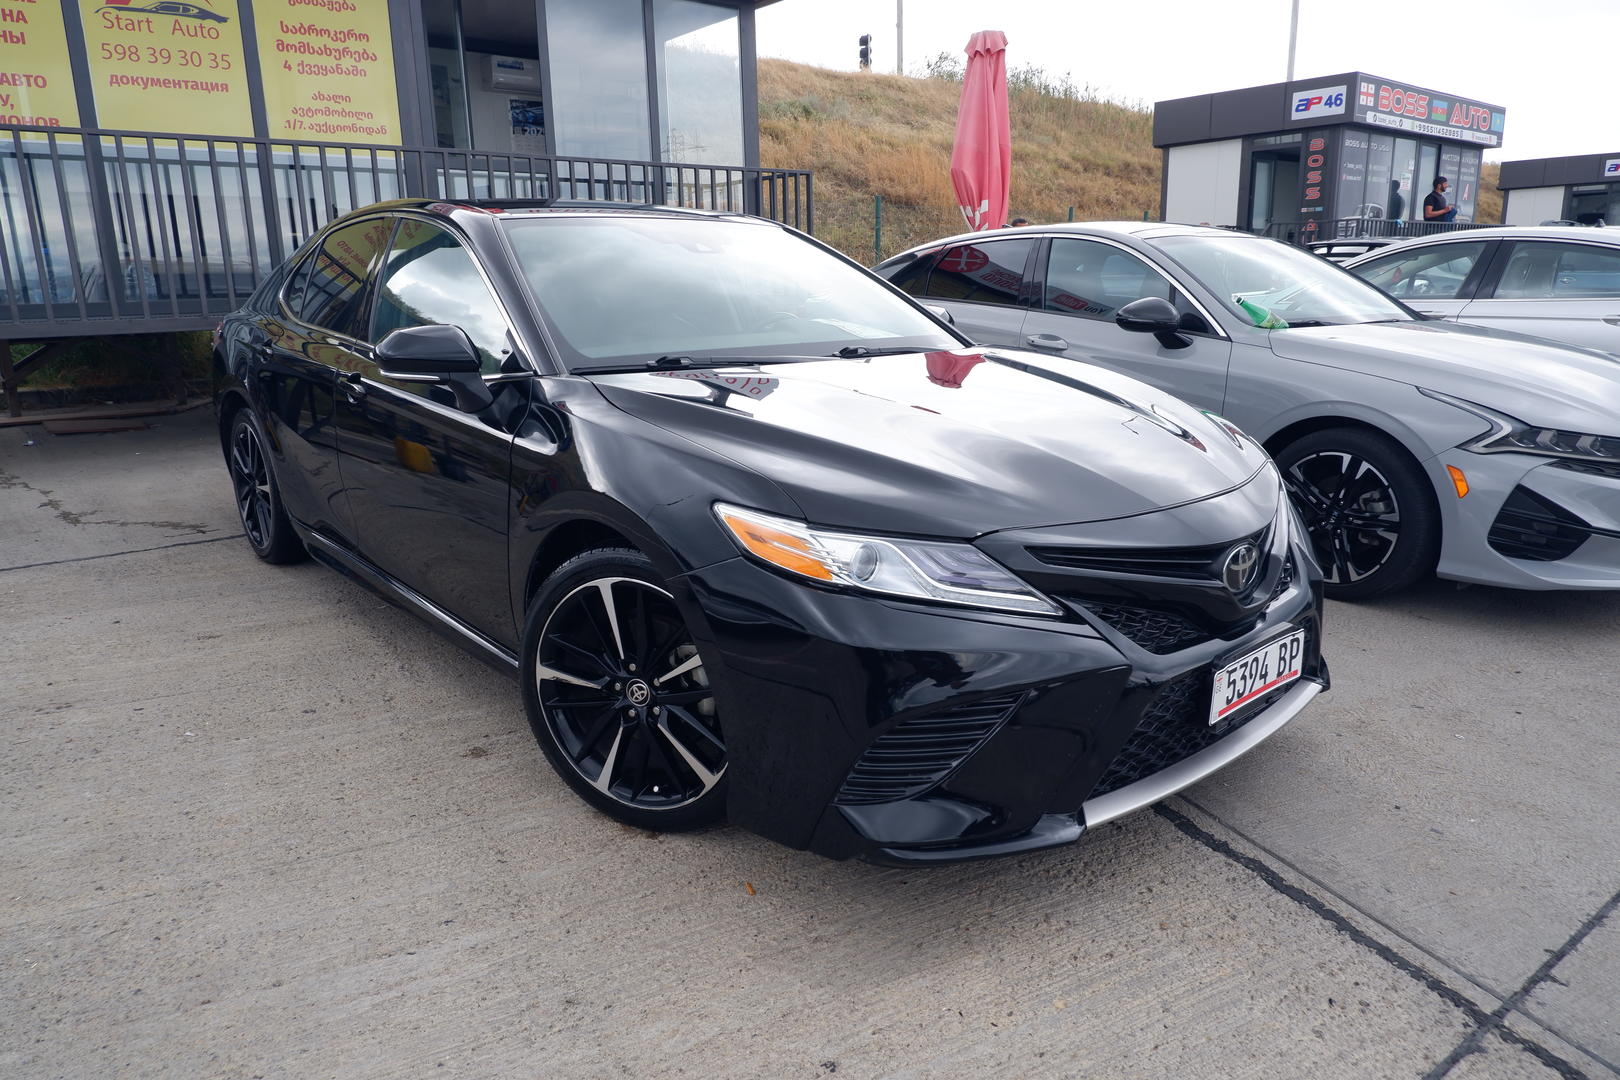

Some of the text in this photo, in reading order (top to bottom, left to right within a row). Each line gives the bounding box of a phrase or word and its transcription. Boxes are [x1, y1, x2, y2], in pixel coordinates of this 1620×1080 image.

[1, 8, 29, 24] НА
[101, 11, 220, 40] Start Auto
[280, 20, 370, 43] საბროკერო
[101, 42, 231, 70] 598 39 30 35
[275, 39, 377, 62] მომსახურება
[283, 59, 367, 77] 4 ქვეყანაში
[109, 74, 229, 94] документация
[311, 91, 352, 104] ახალი
[1324, 92, 1343, 108] 46
[291, 105, 373, 121] ავტომობილი
[1378, 85, 1491, 131] BOSS AUTO
[308, 121, 387, 136] აუქციონიდან
[1226, 637, 1300, 705] 5394 BP
